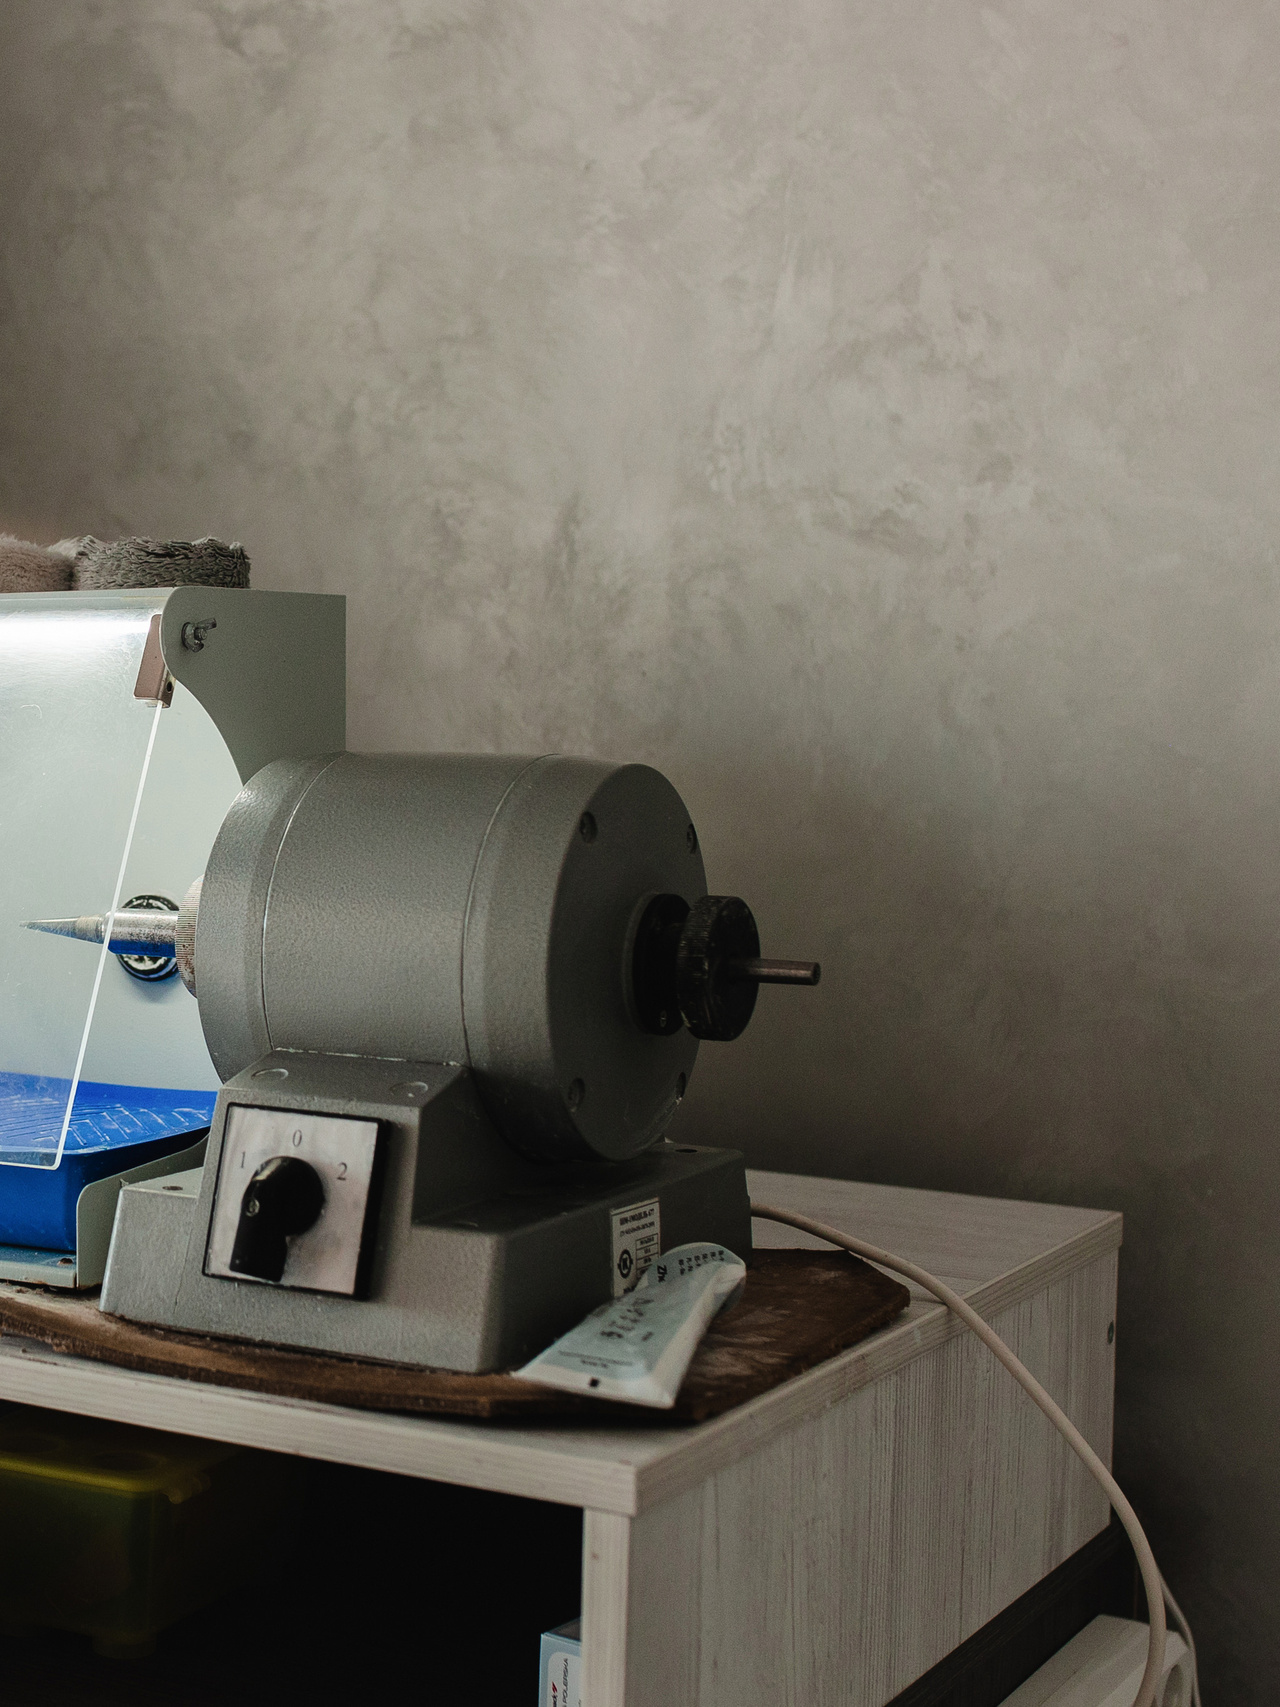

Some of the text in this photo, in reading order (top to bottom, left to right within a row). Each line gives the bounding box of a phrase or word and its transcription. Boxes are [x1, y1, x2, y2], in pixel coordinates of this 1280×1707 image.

[292, 1129, 303, 1147] 0
[240, 1151, 247, 1168] 1
[337, 1162, 348, 1181] 2
